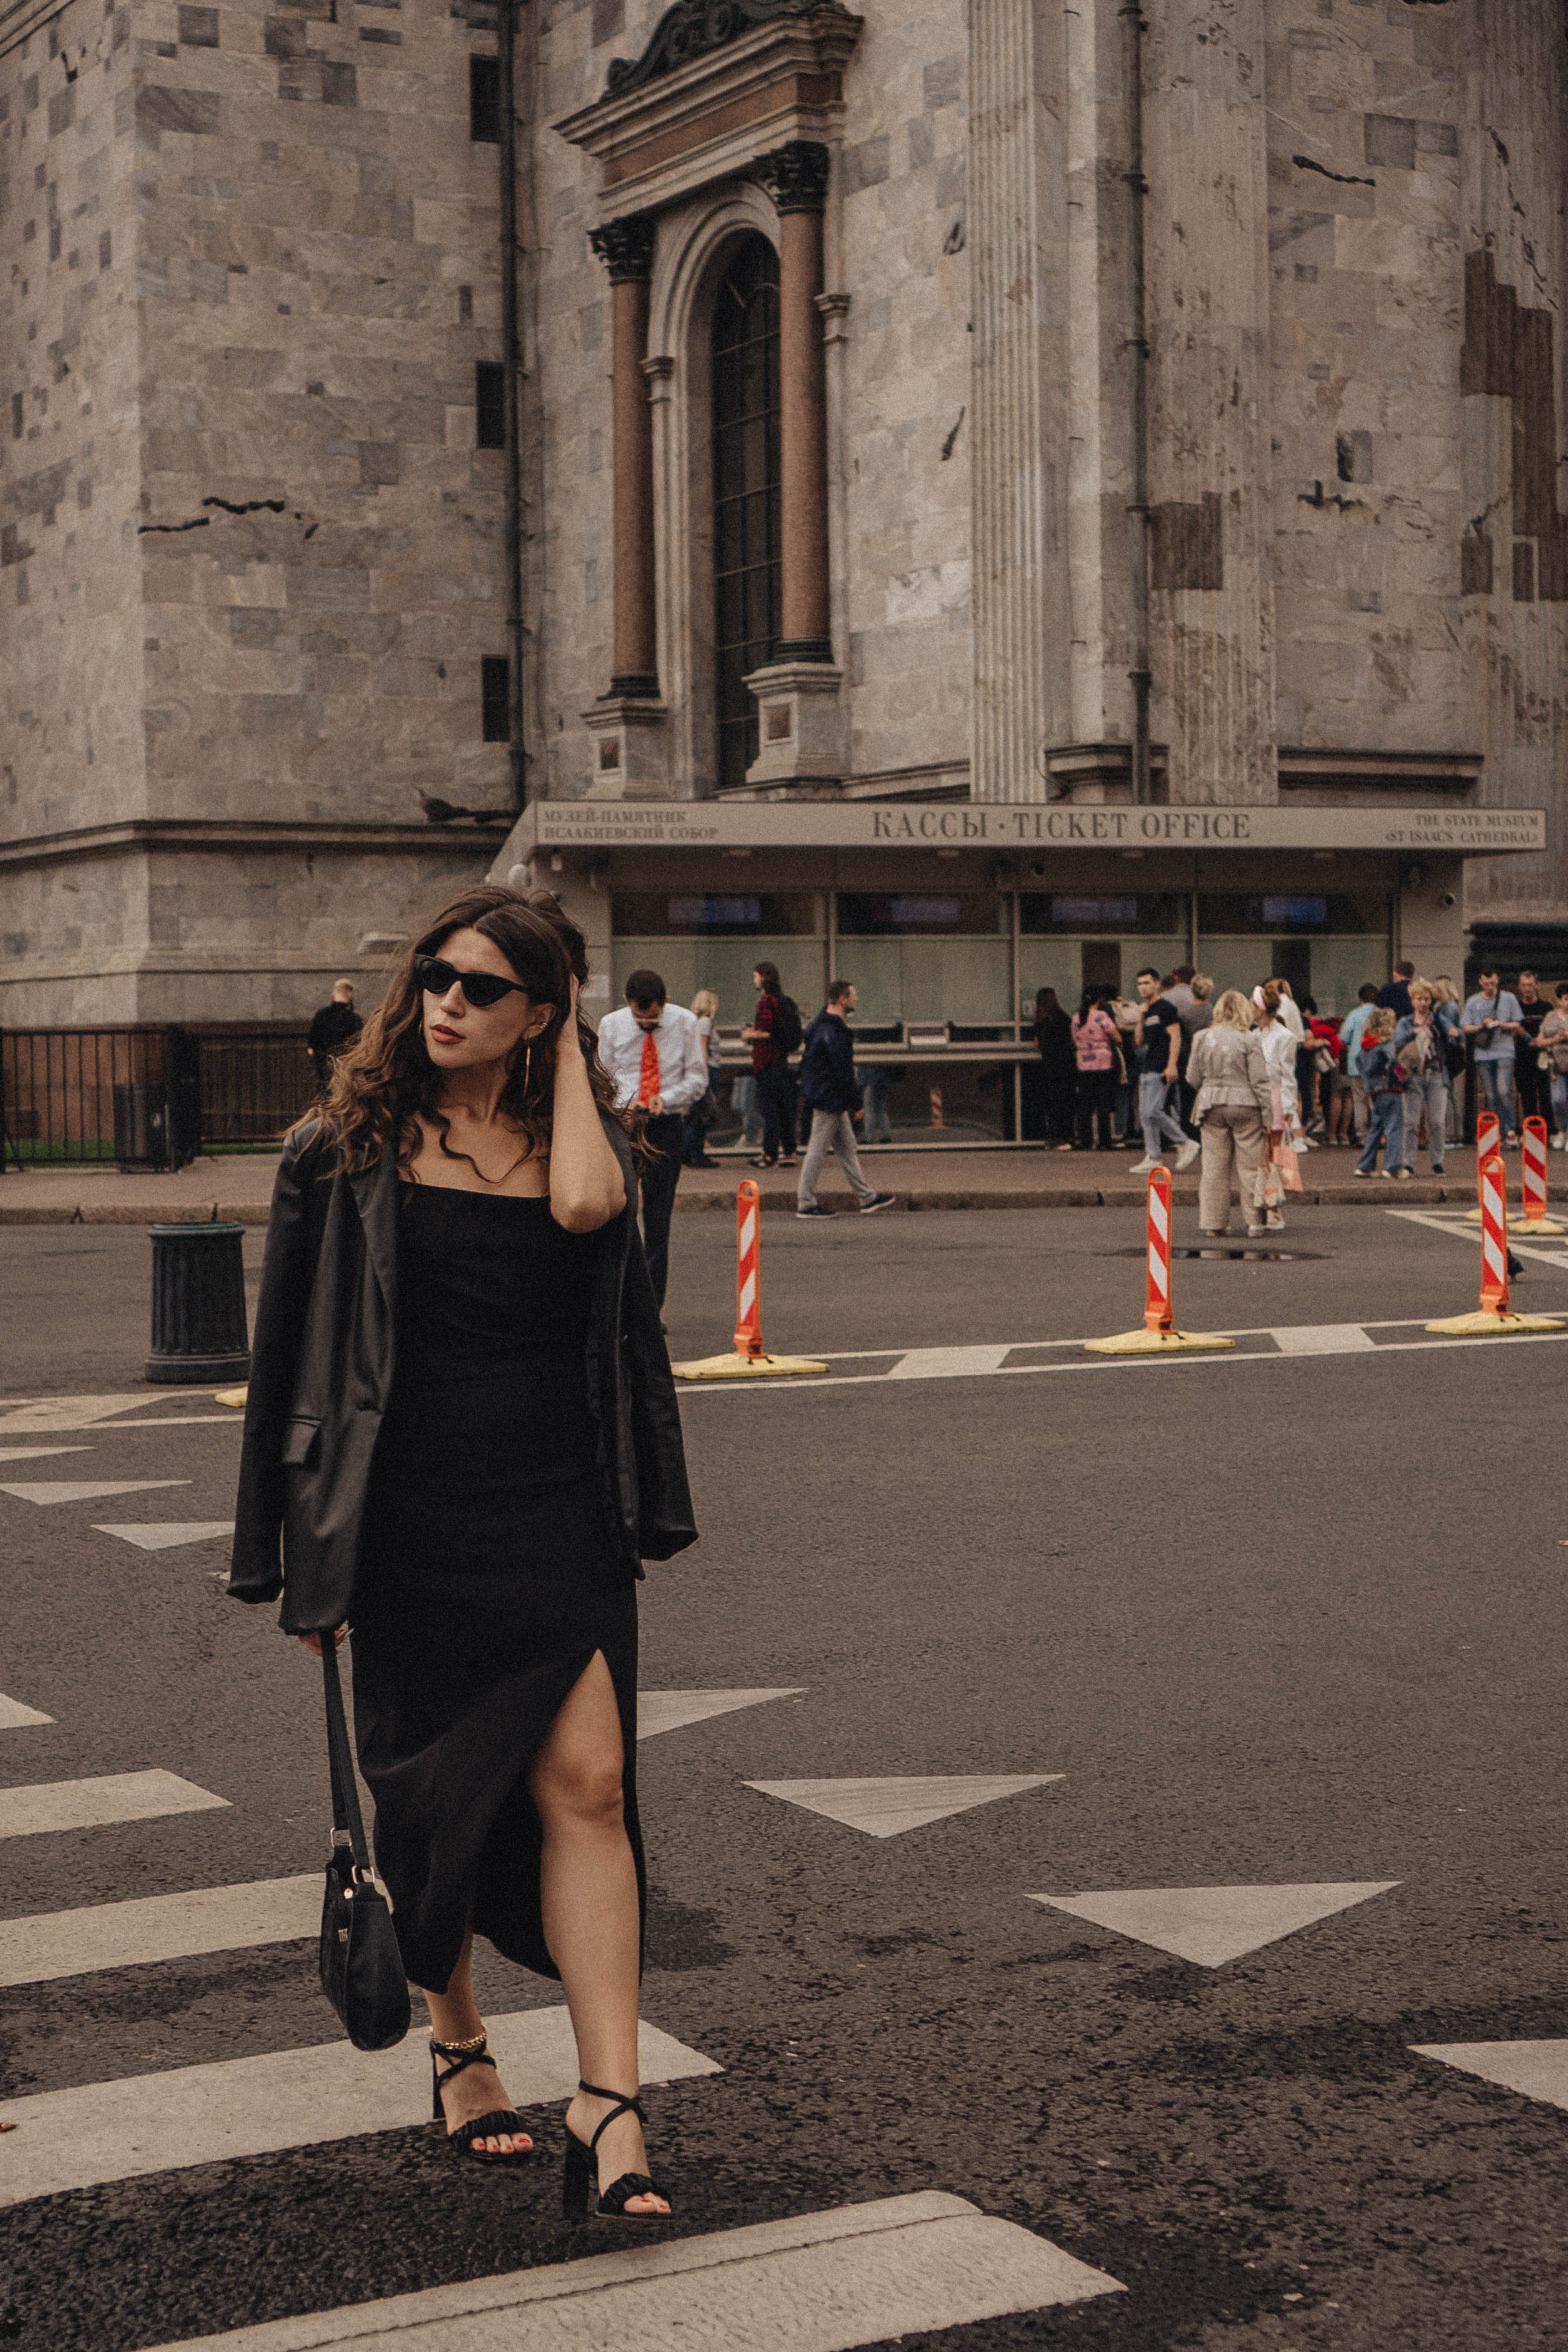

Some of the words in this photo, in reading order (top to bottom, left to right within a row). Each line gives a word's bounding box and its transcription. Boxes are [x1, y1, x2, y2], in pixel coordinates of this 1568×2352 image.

[873, 811, 988, 839] КАССЫ
[1013, 812, 1128, 839] TICKET
[1140, 812, 1251, 839] OFFICE
[1416, 814, 1440, 826] THE
[1444, 814, 1480, 826] STATE
[1486, 815, 1539, 826] MUSEUM
[669, 826, 719, 839] СОБОР
